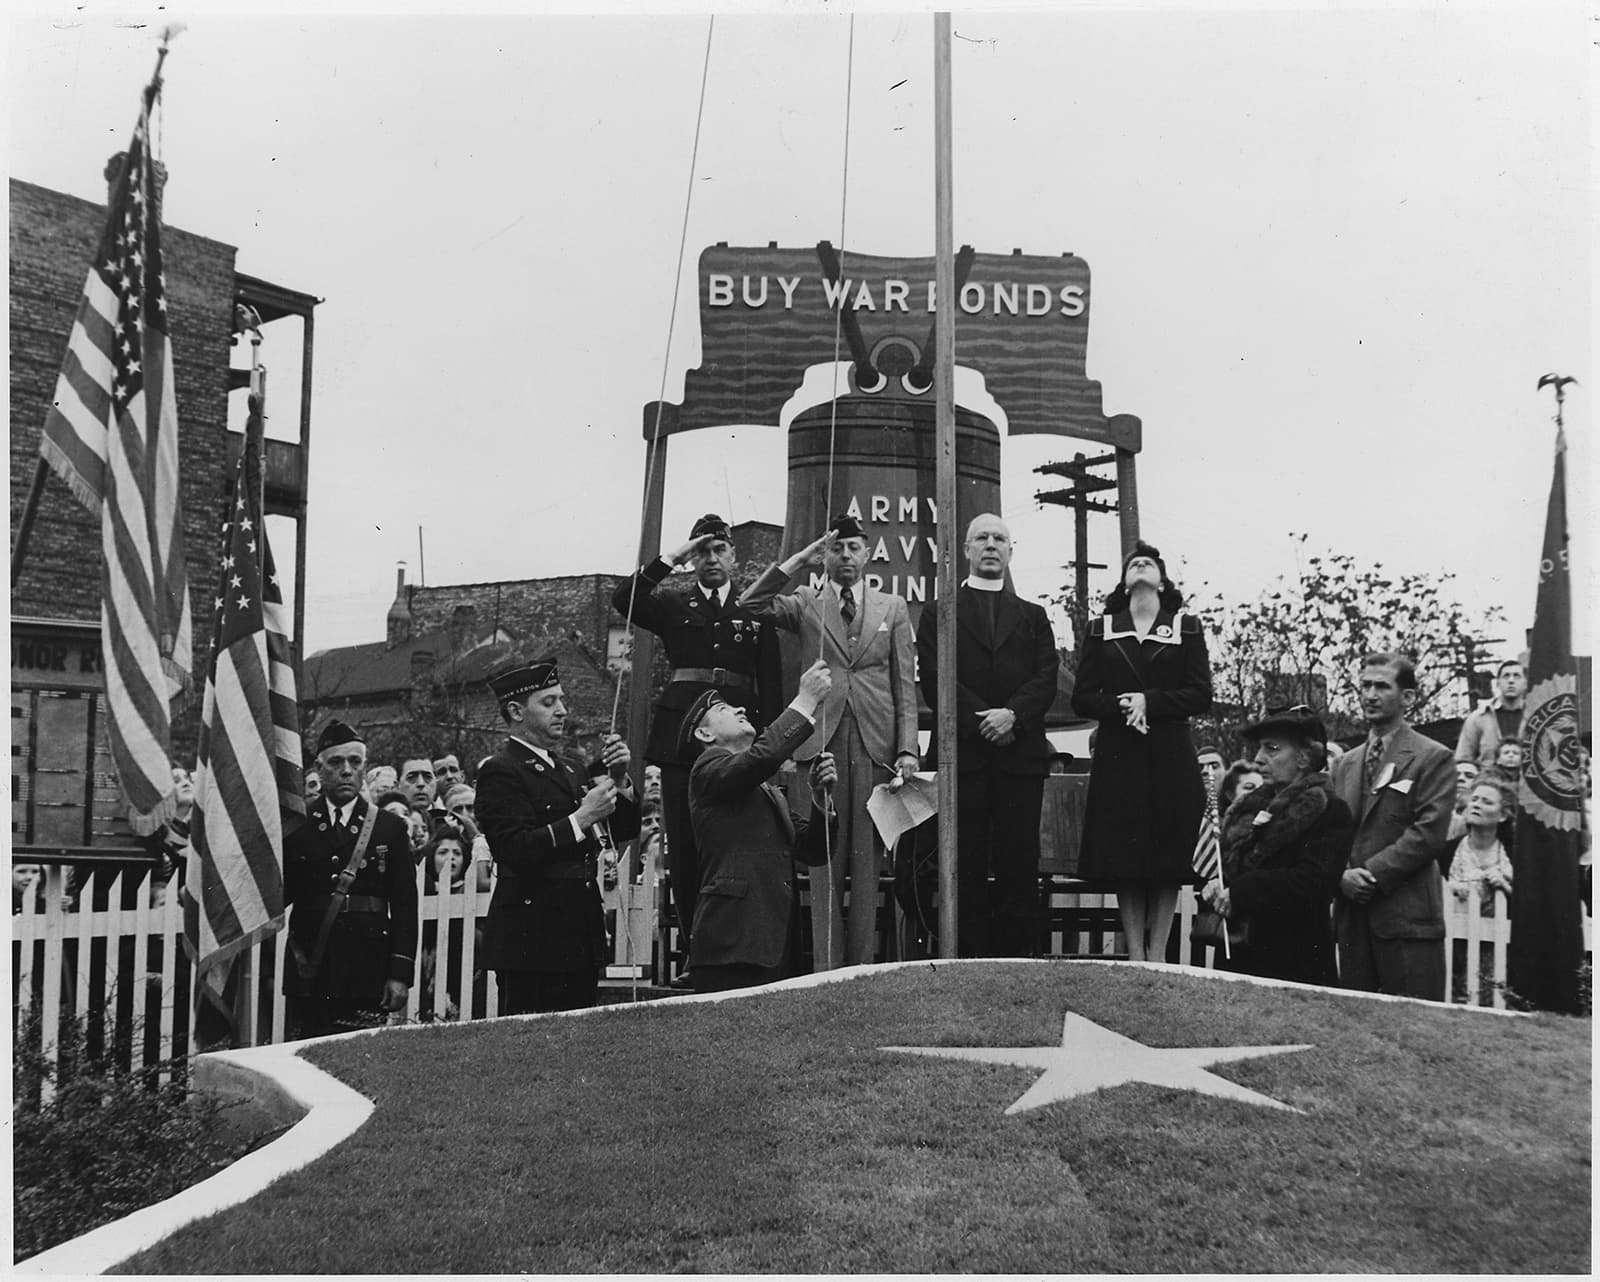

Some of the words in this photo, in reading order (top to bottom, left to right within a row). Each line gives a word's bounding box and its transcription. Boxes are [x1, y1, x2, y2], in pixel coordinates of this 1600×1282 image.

[708, 274, 801, 309] BUY
[822, 278, 910, 313] WAR
[846, 495, 938, 523] ARMY
[871, 535, 938, 563] AVY
[1521, 695, 1575, 779] AMERICA
